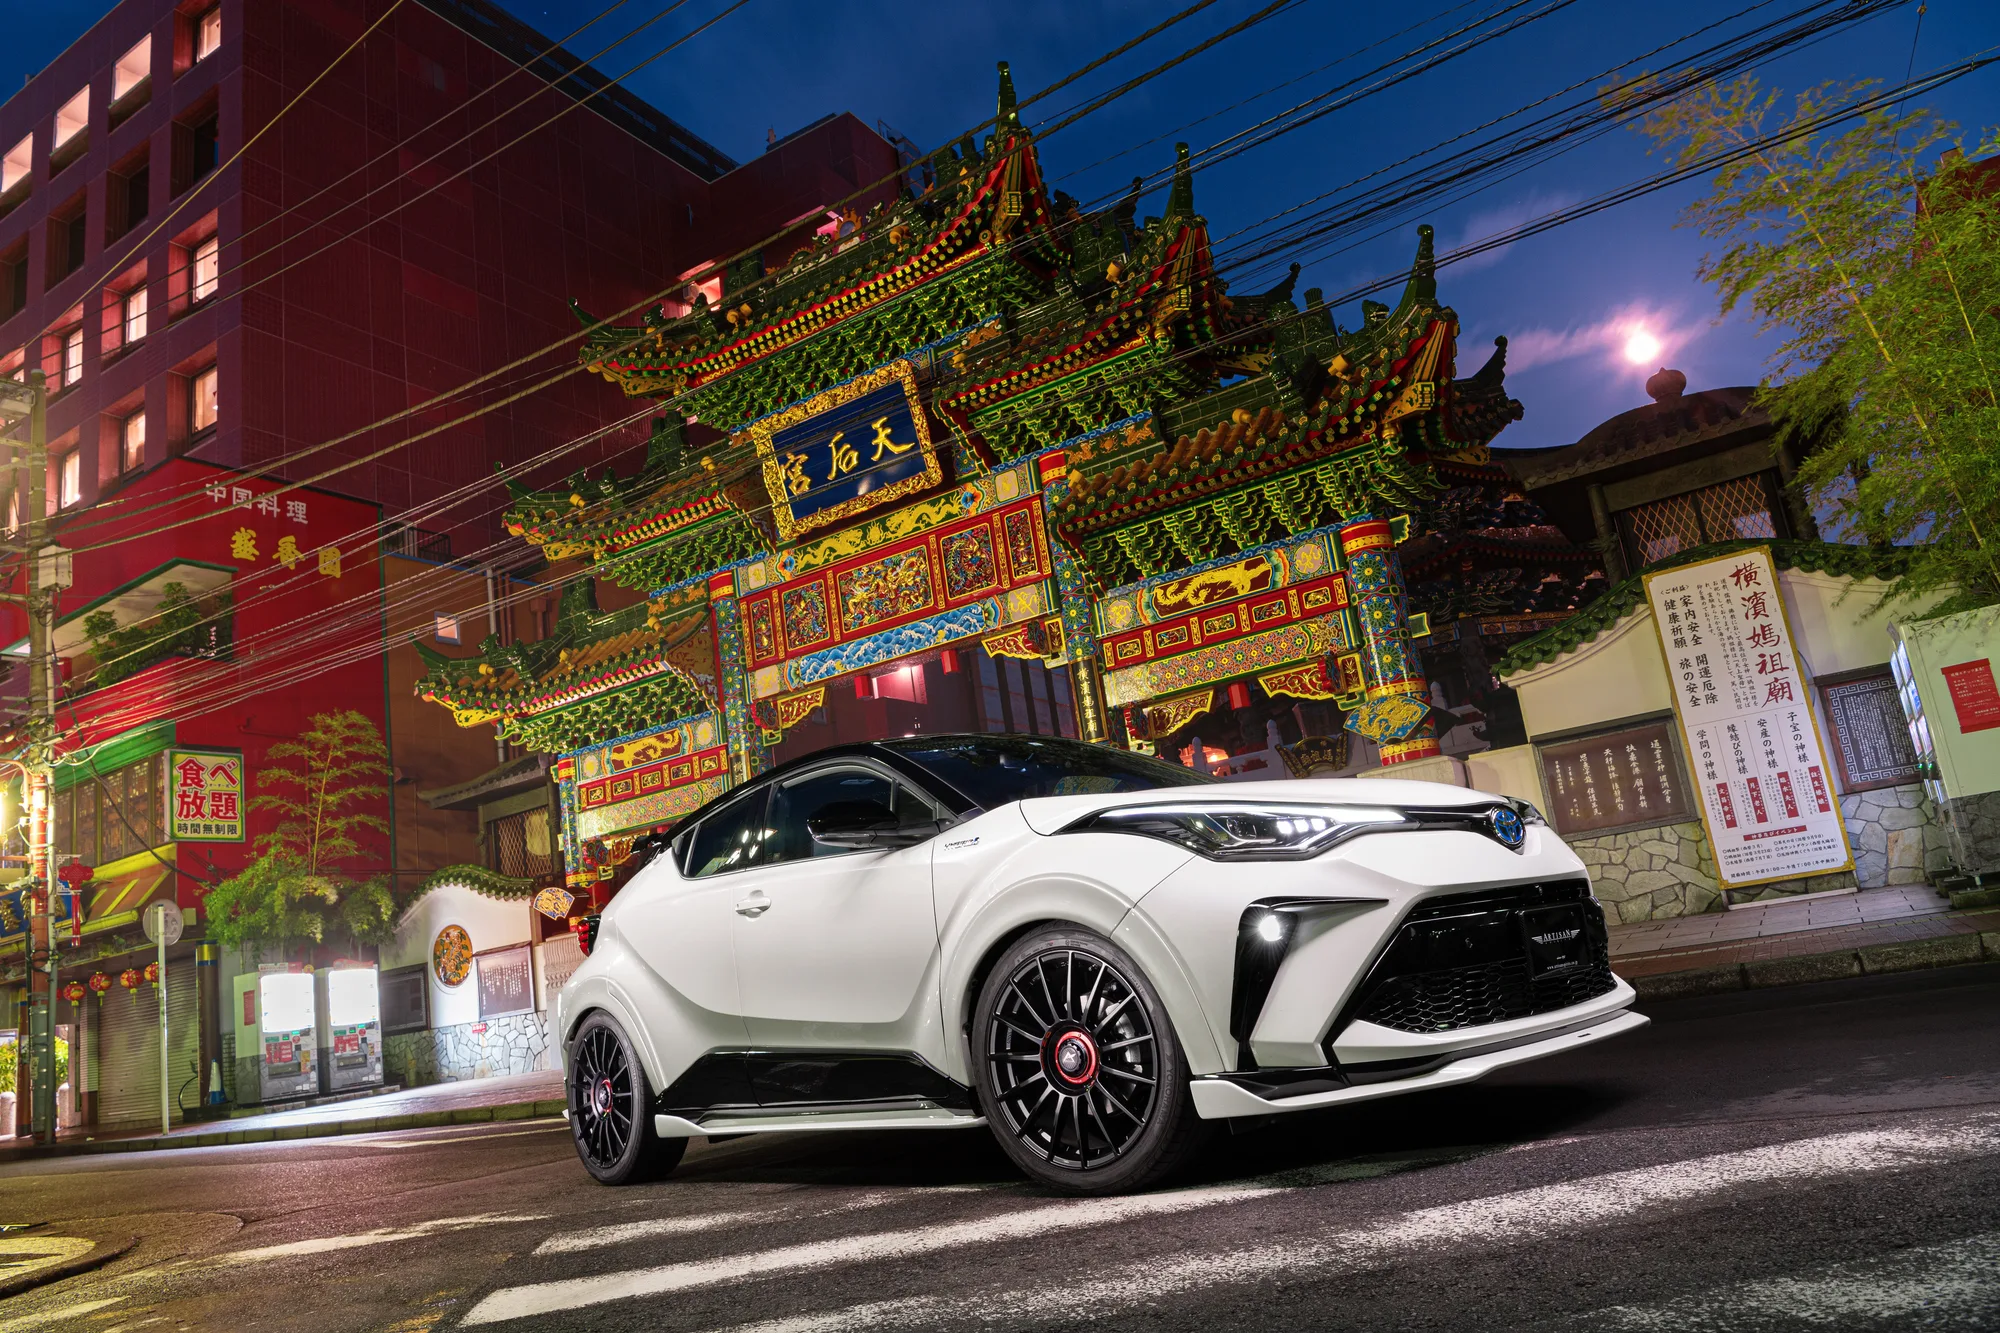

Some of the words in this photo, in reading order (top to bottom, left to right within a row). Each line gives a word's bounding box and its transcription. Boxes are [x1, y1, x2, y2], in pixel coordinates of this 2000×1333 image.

[780, 415, 916, 496] 天后宮
[205, 480, 309, 525] 中国料理
[1663, 598, 1688, 649] 健康祈願
[1679, 658, 1701, 708] 旅の安全
[1679, 594, 1703, 646] 家内安全
[1695, 653, 1719, 705] 開運厄除
[1728, 560, 1794, 709] 横濱媽祖廟
[1696, 729, 1719, 780] 学問の神様
[1726, 723, 1749, 775] 縁結びの神様
[1756, 718, 1779, 769] 安産の神様
[1786, 711, 1810, 763] 子宝の神様
[176, 757, 239, 789] 食べ
[176, 789, 239, 820] 放題
[1749, 782, 1763, 816] 月下老人
[177, 822, 238, 835] 時間無制限
[1543, 929, 1571, 942] ARTISAN
[1156, 1067, 1174, 1125] YOKOHAMA
